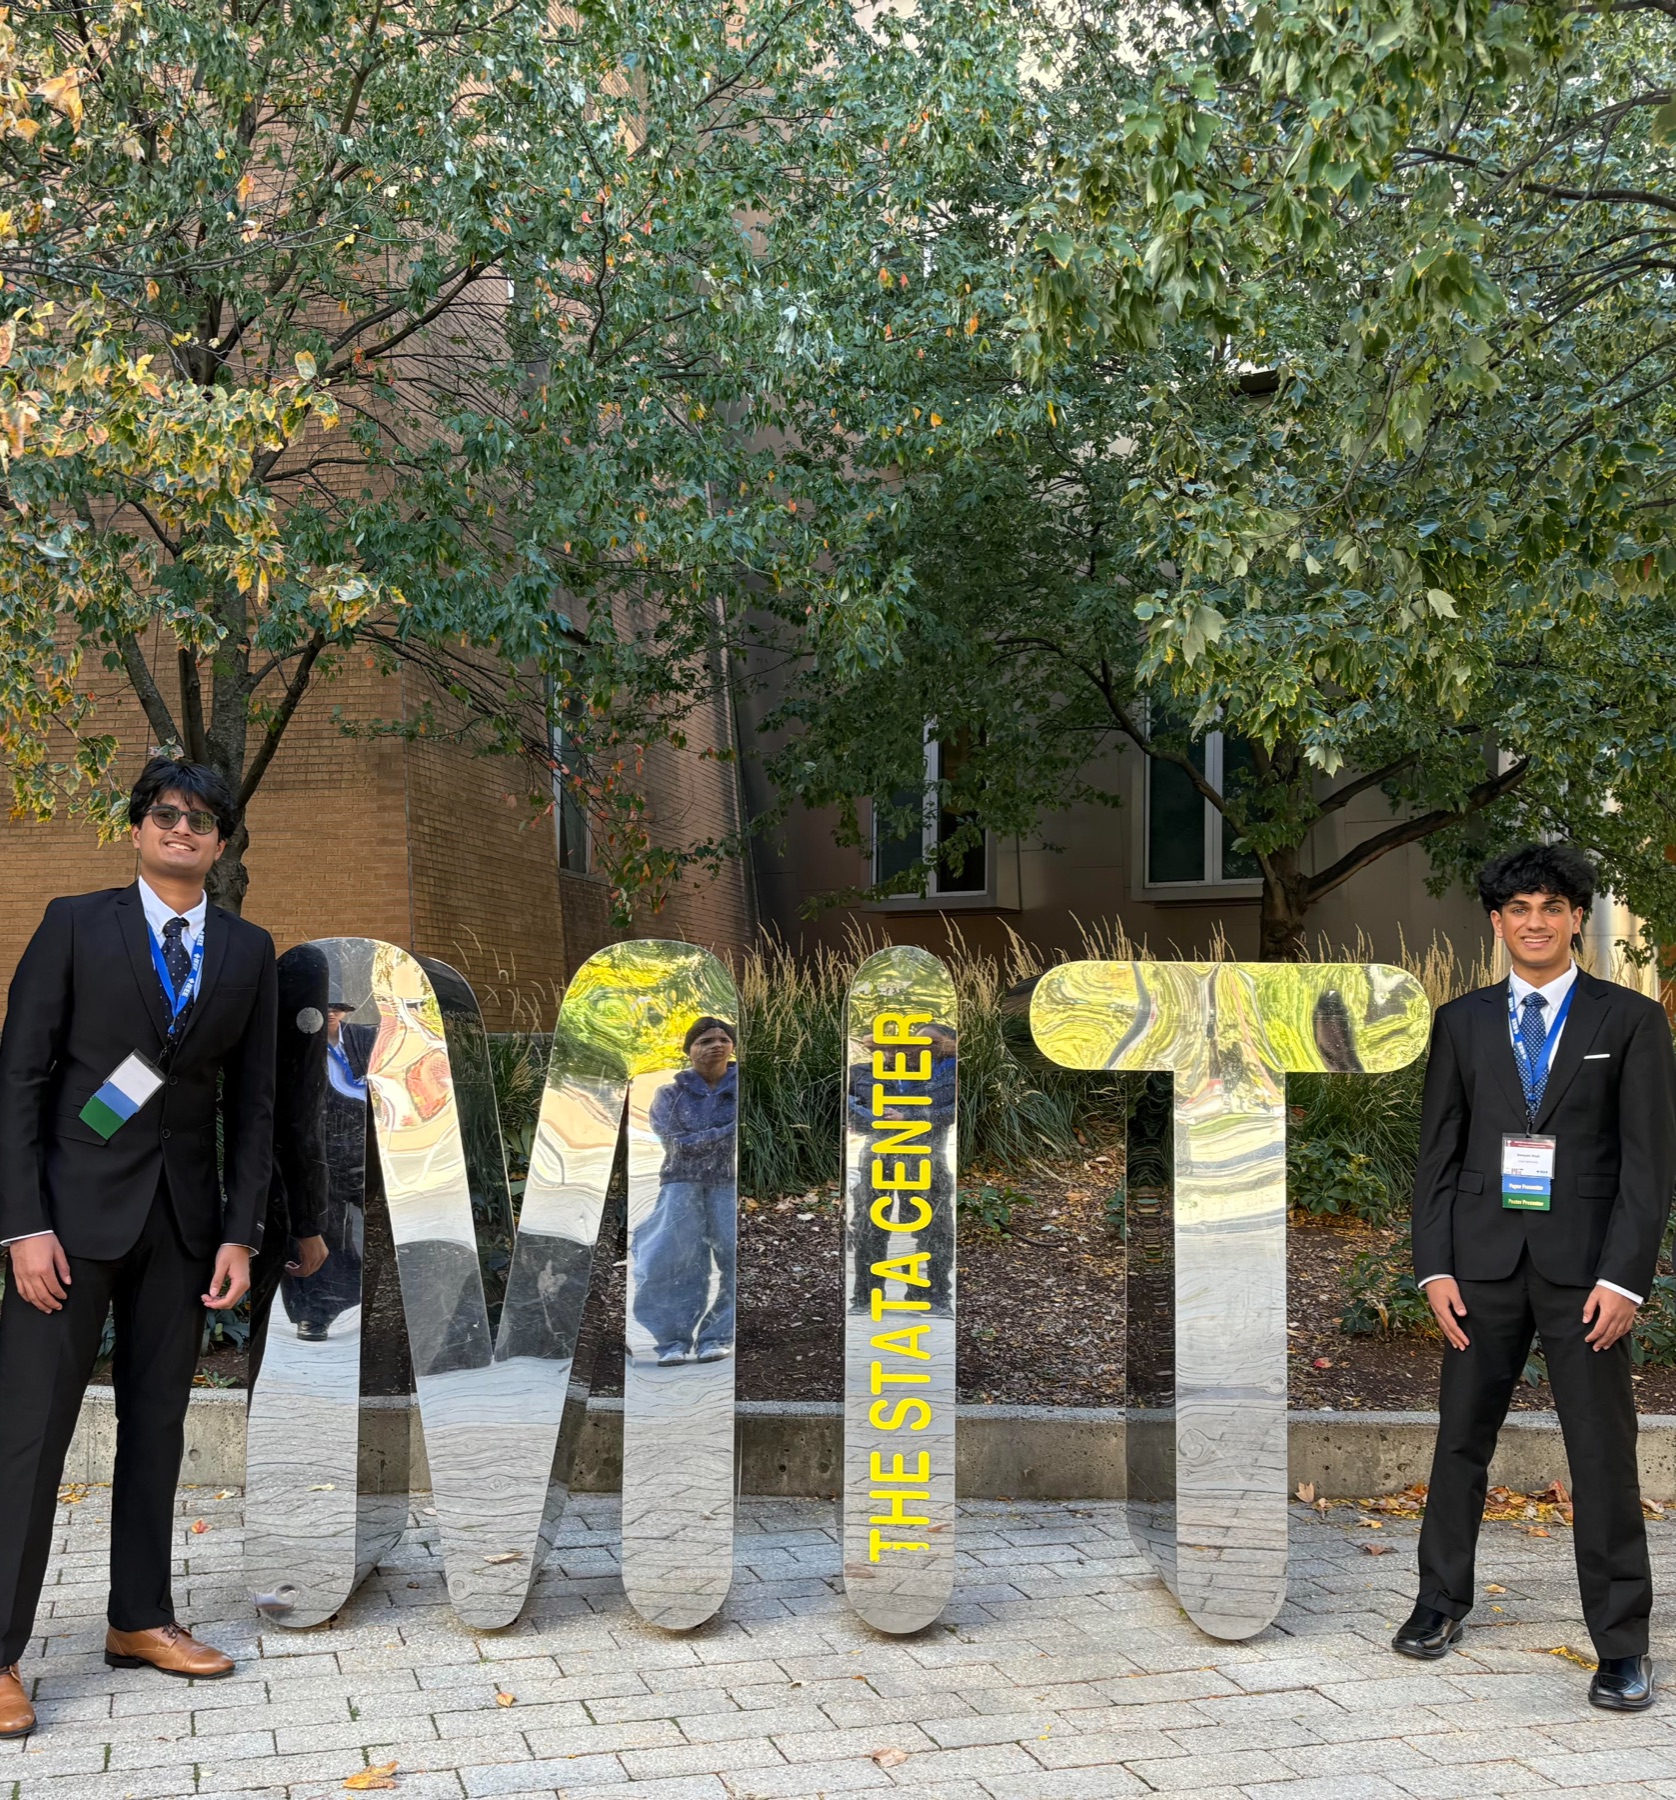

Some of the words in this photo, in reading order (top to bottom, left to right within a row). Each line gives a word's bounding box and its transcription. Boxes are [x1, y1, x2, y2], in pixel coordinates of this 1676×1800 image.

[871, 1013, 933, 1232] CENTER
[244, 939, 1430, 1641] MIT
[870, 1253, 931, 1430] STATA
[870, 1451, 931, 1563] THE
